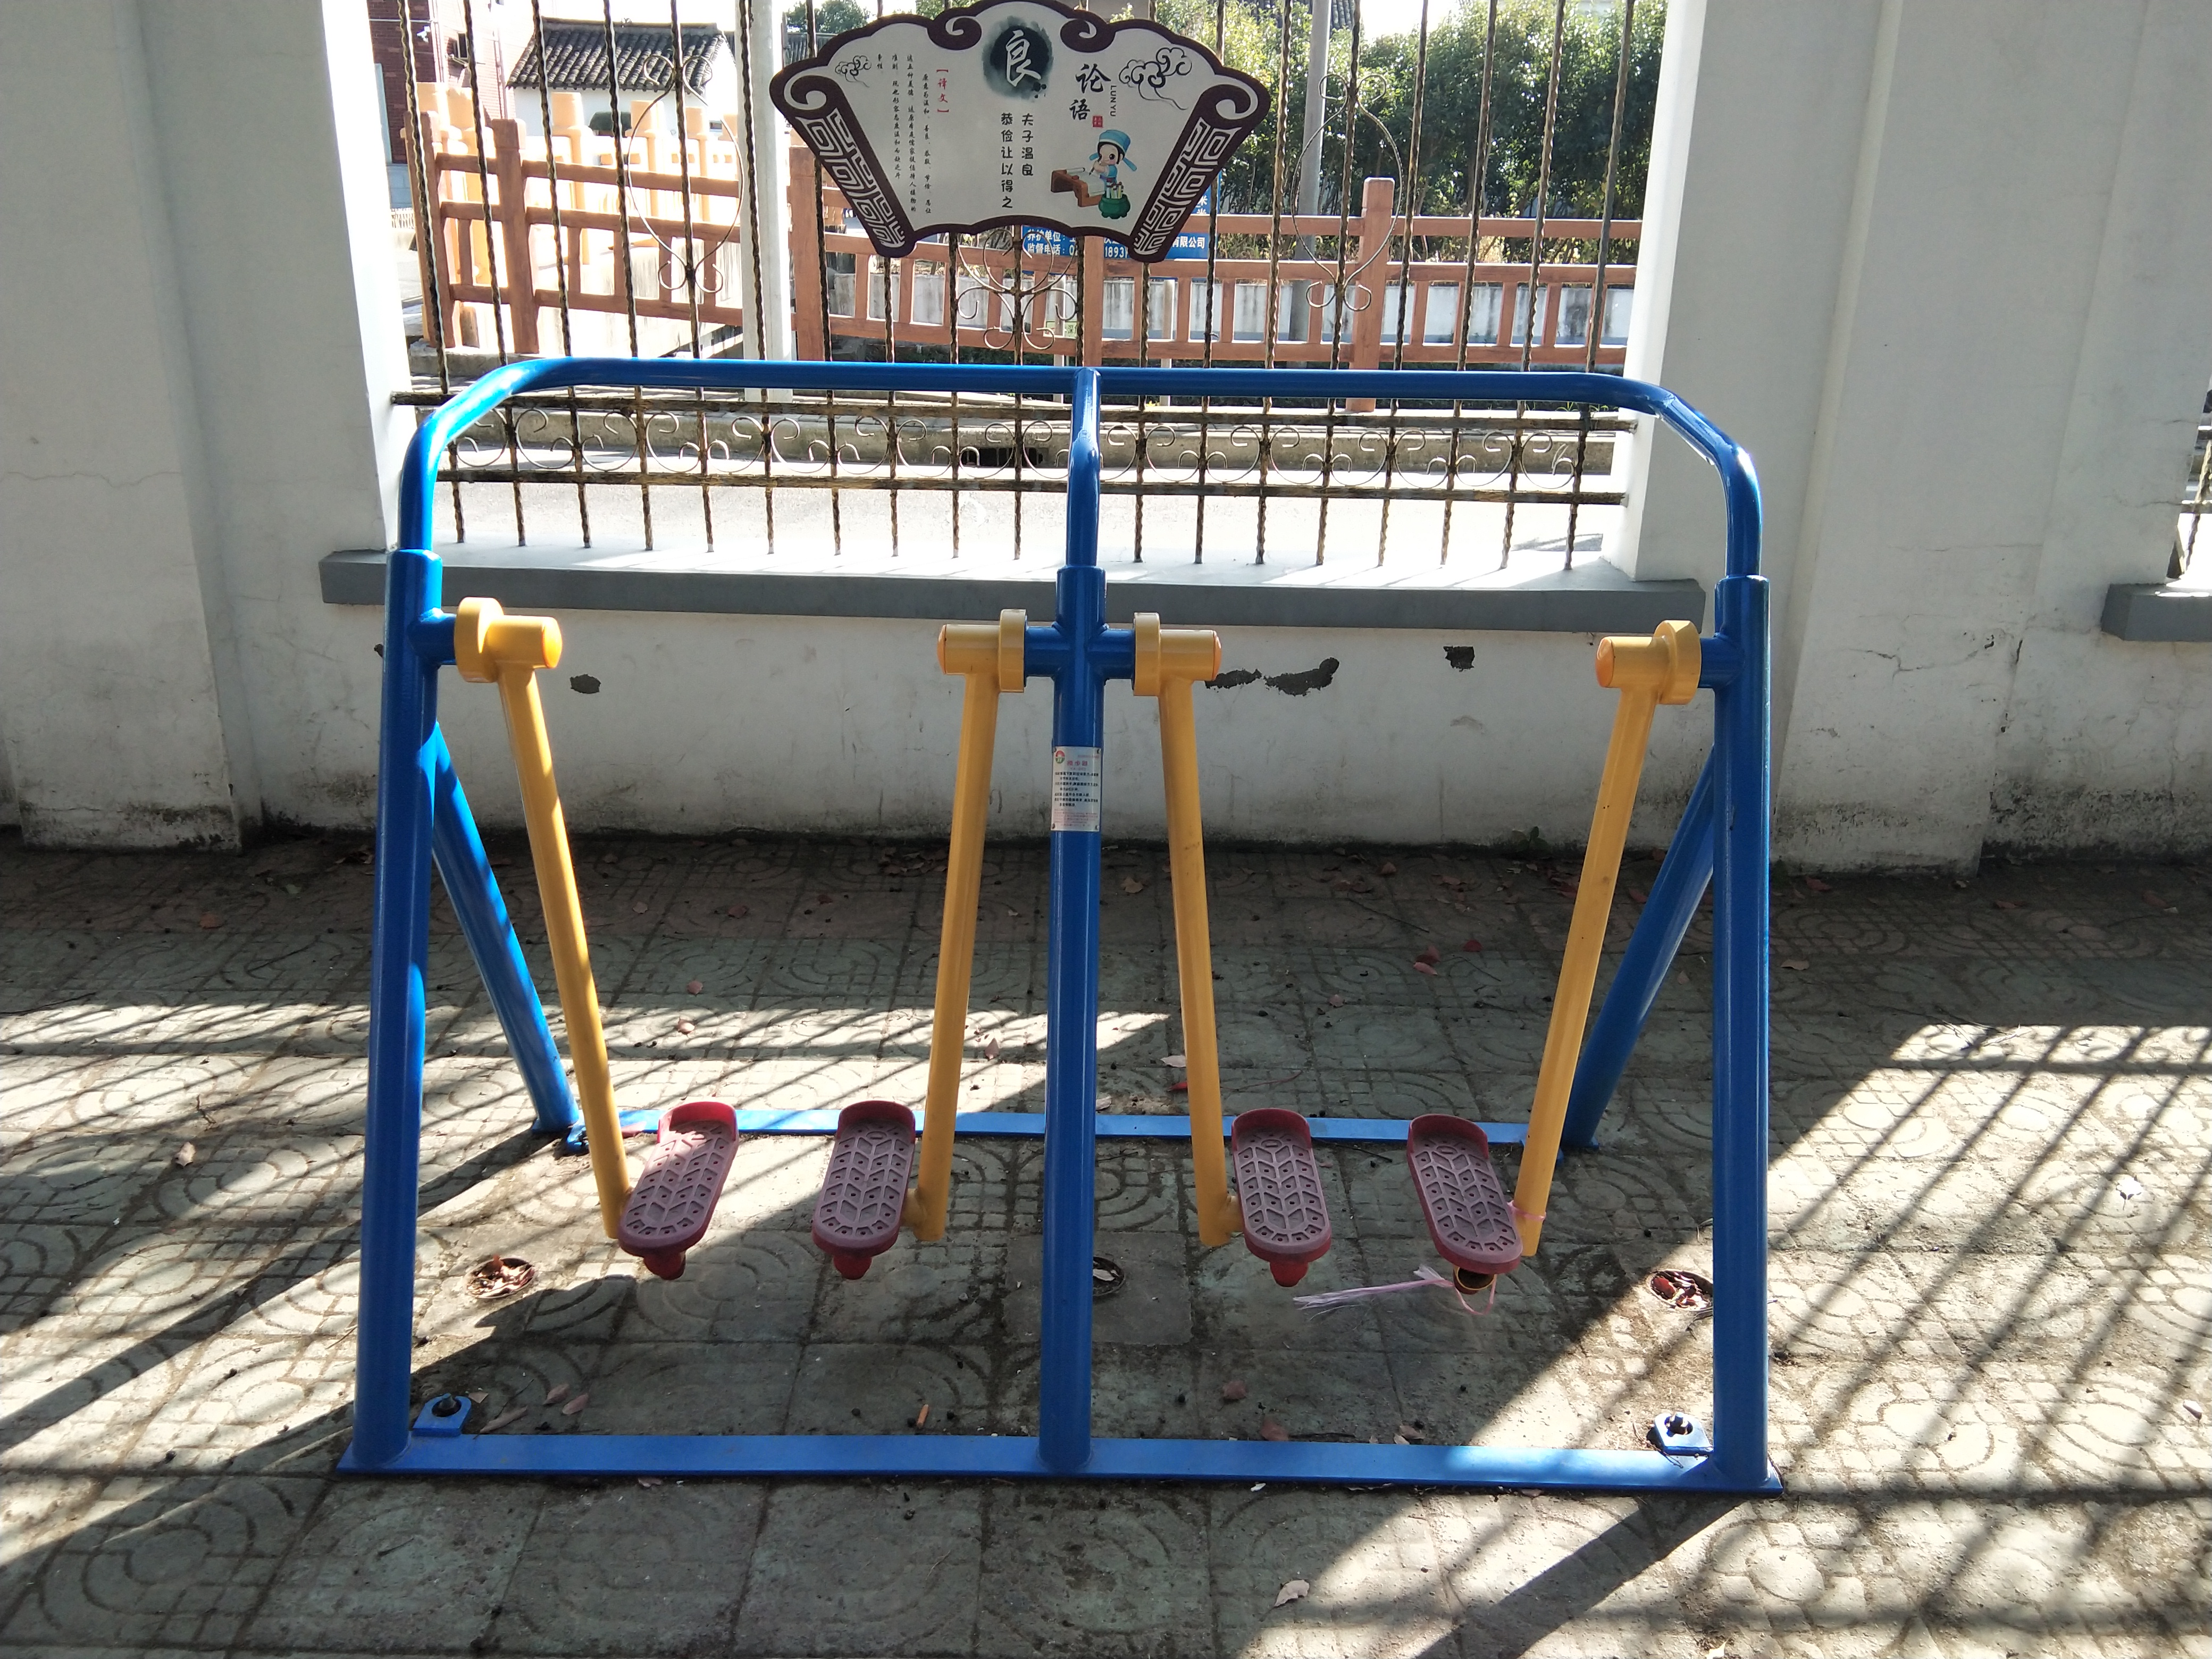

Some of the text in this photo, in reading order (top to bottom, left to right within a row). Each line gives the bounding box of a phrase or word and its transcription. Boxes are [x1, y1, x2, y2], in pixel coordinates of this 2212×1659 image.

[1006, 29, 1042, 87] 良
[1069, 63, 1111, 120] 论语
[1001, 112, 1013, 208] 恭俭让以得之
[1021, 113, 1034, 176] 夫子温良
